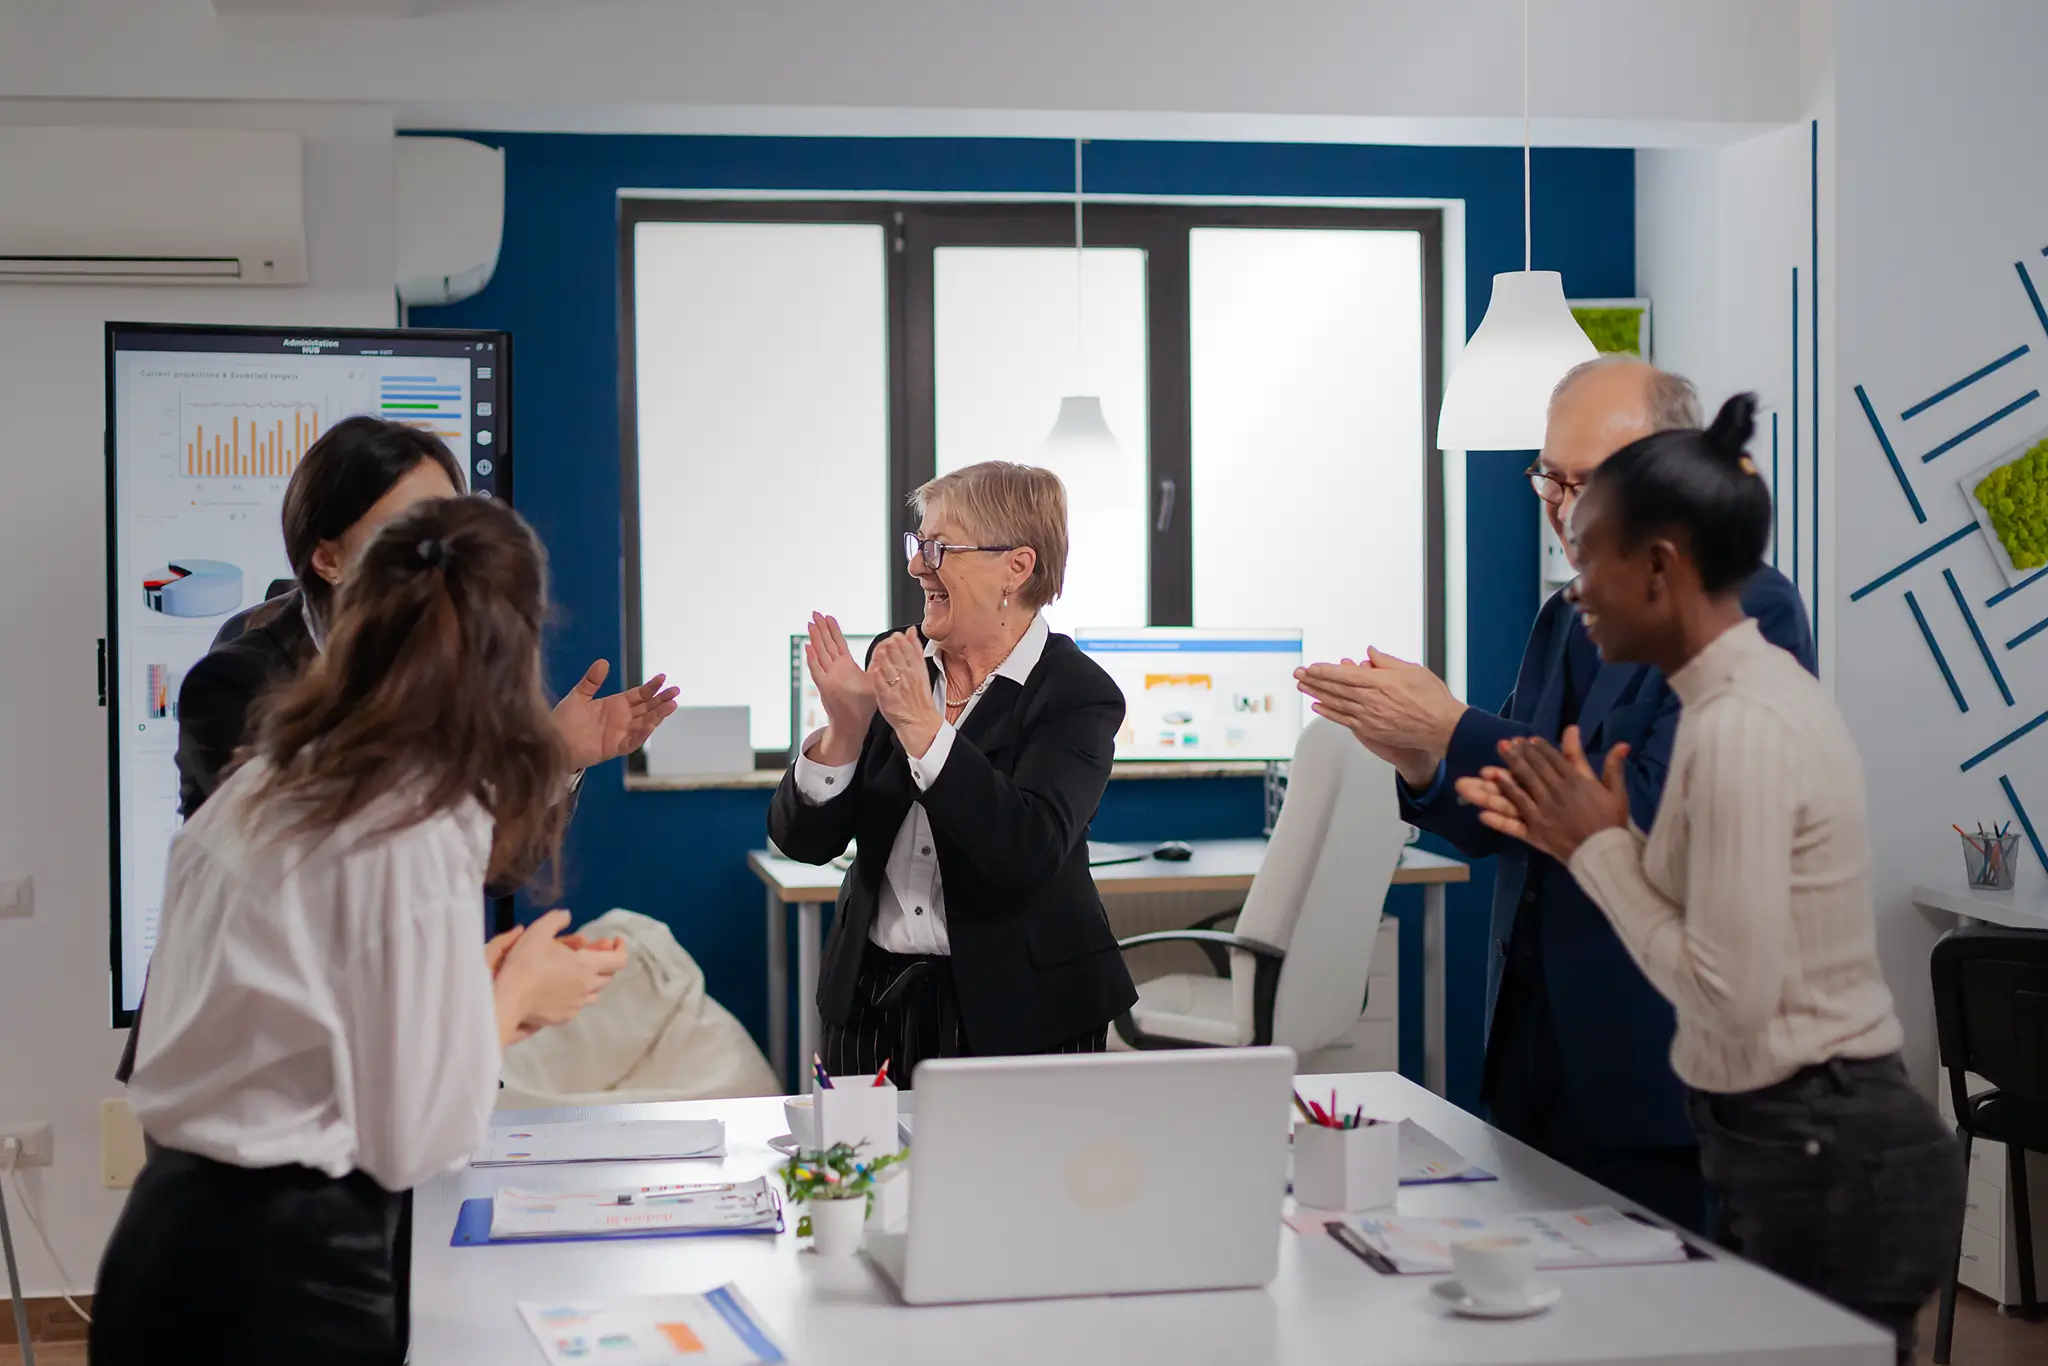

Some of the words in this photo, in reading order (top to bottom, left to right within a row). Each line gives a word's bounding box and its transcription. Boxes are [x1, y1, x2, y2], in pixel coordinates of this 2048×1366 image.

[139, 369, 171, 378] Current
[173, 370, 219, 380] projections
[230, 371, 268, 381] Expected
[270, 372, 299, 381] targets
